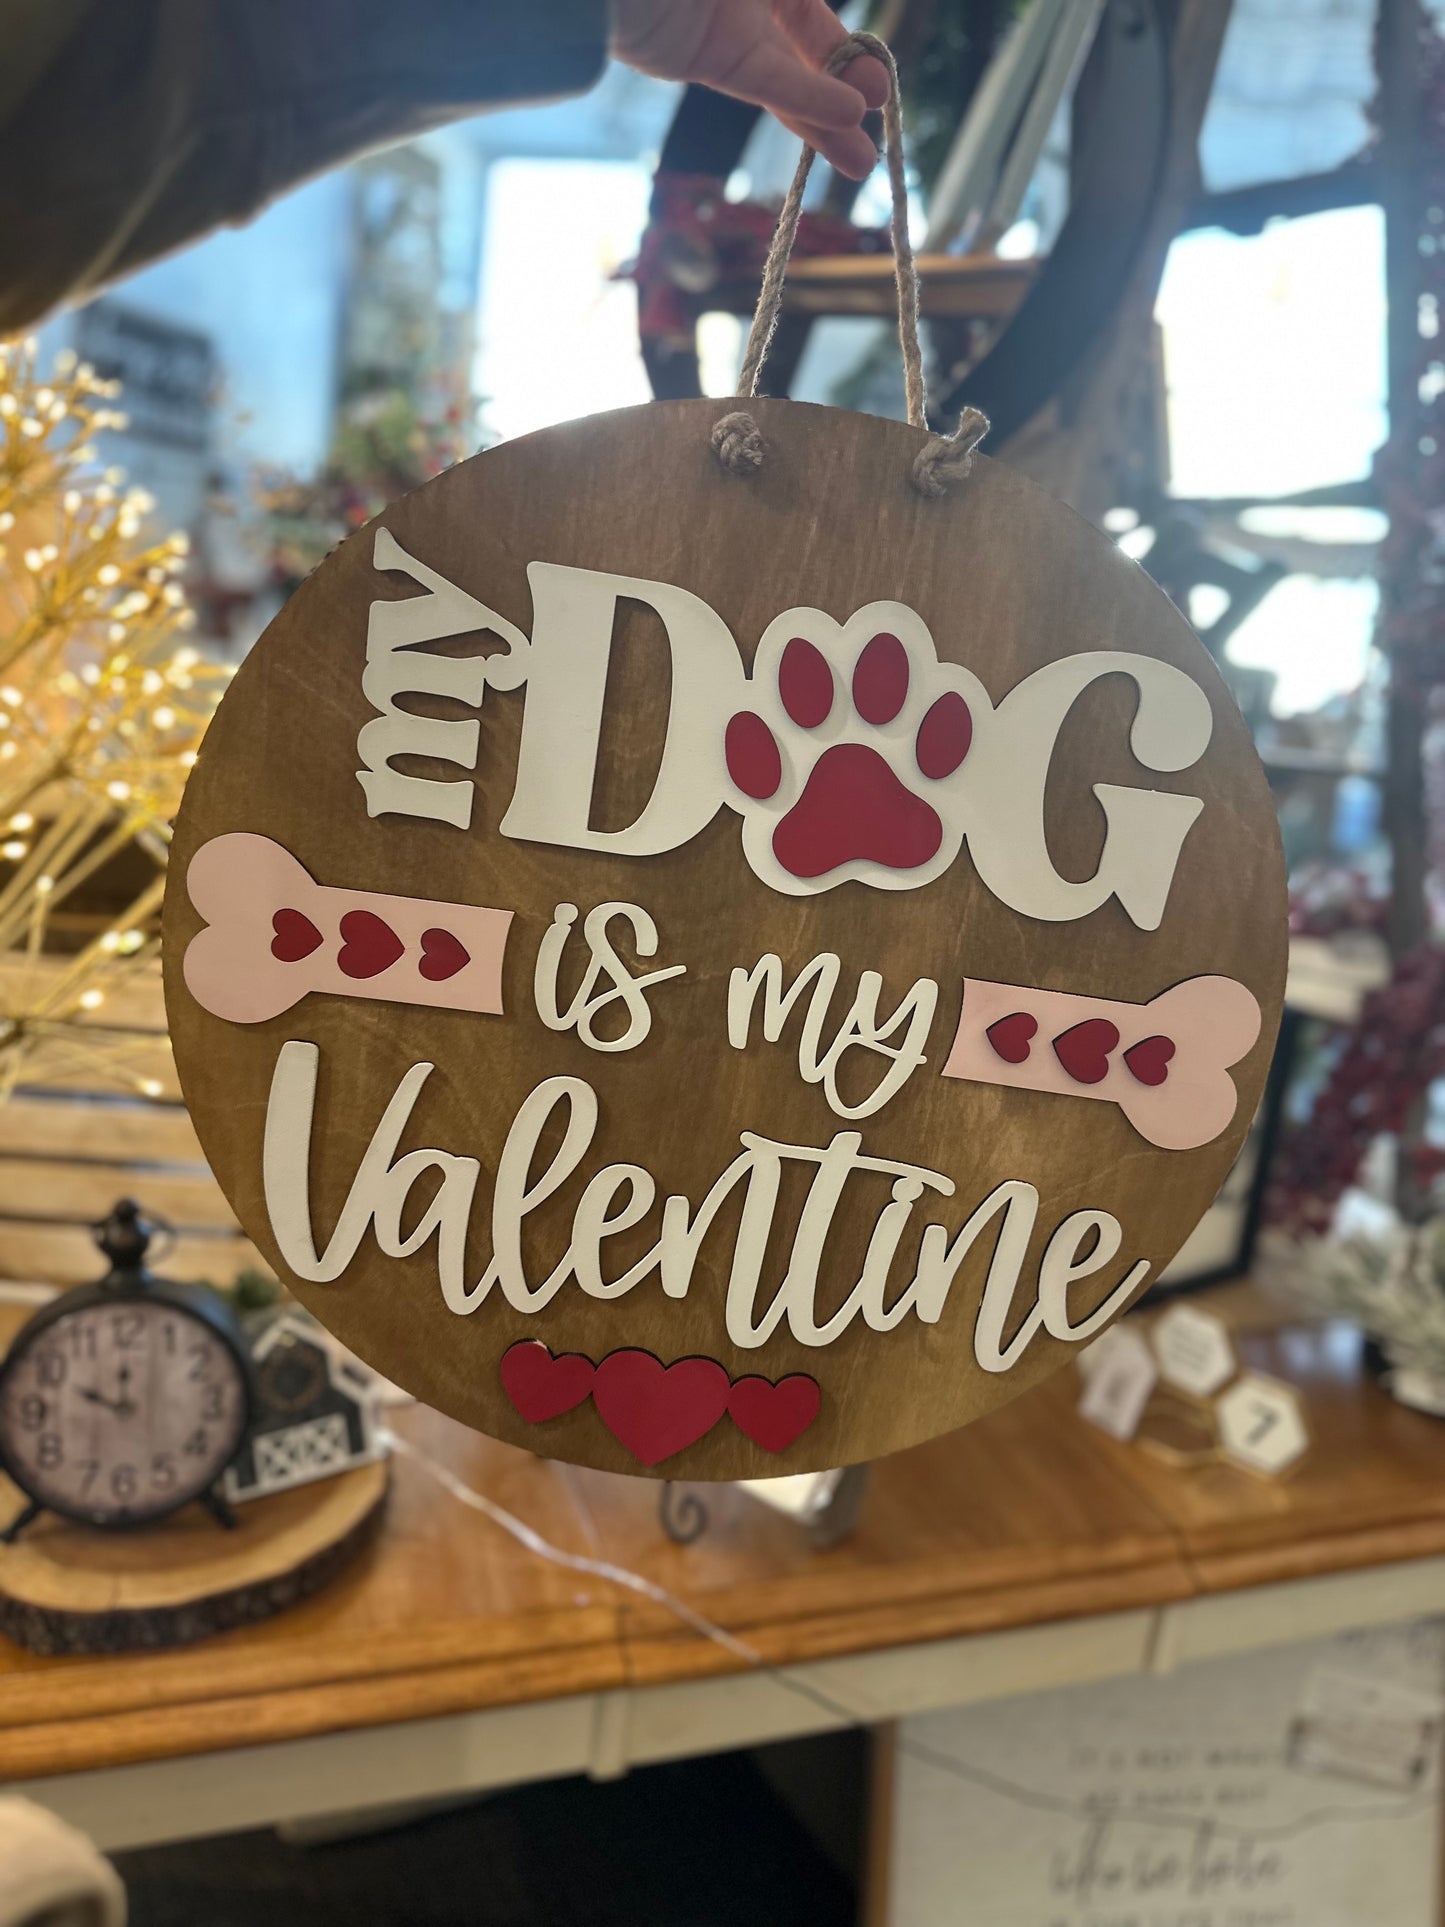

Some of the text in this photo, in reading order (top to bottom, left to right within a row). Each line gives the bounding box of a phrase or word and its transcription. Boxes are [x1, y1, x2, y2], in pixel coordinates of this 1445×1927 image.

[356, 527, 532, 830] my
[534, 901, 939, 1120] is my
[263, 1041, 1152, 1373] Valentine
[68, 1322, 98, 1361] 11
[112, 1314, 147, 1352] 12
[187, 1343, 213, 1383] 2
[20, 1393, 47, 1432] 9
[204, 1383, 225, 1422] 3
[36, 1431, 64, 1471] 8
[183, 1428, 207, 1458] 4
[78, 1457, 100, 1497] 7
[110, 1462, 138, 1500] 6
[151, 1451, 178, 1491] 5
